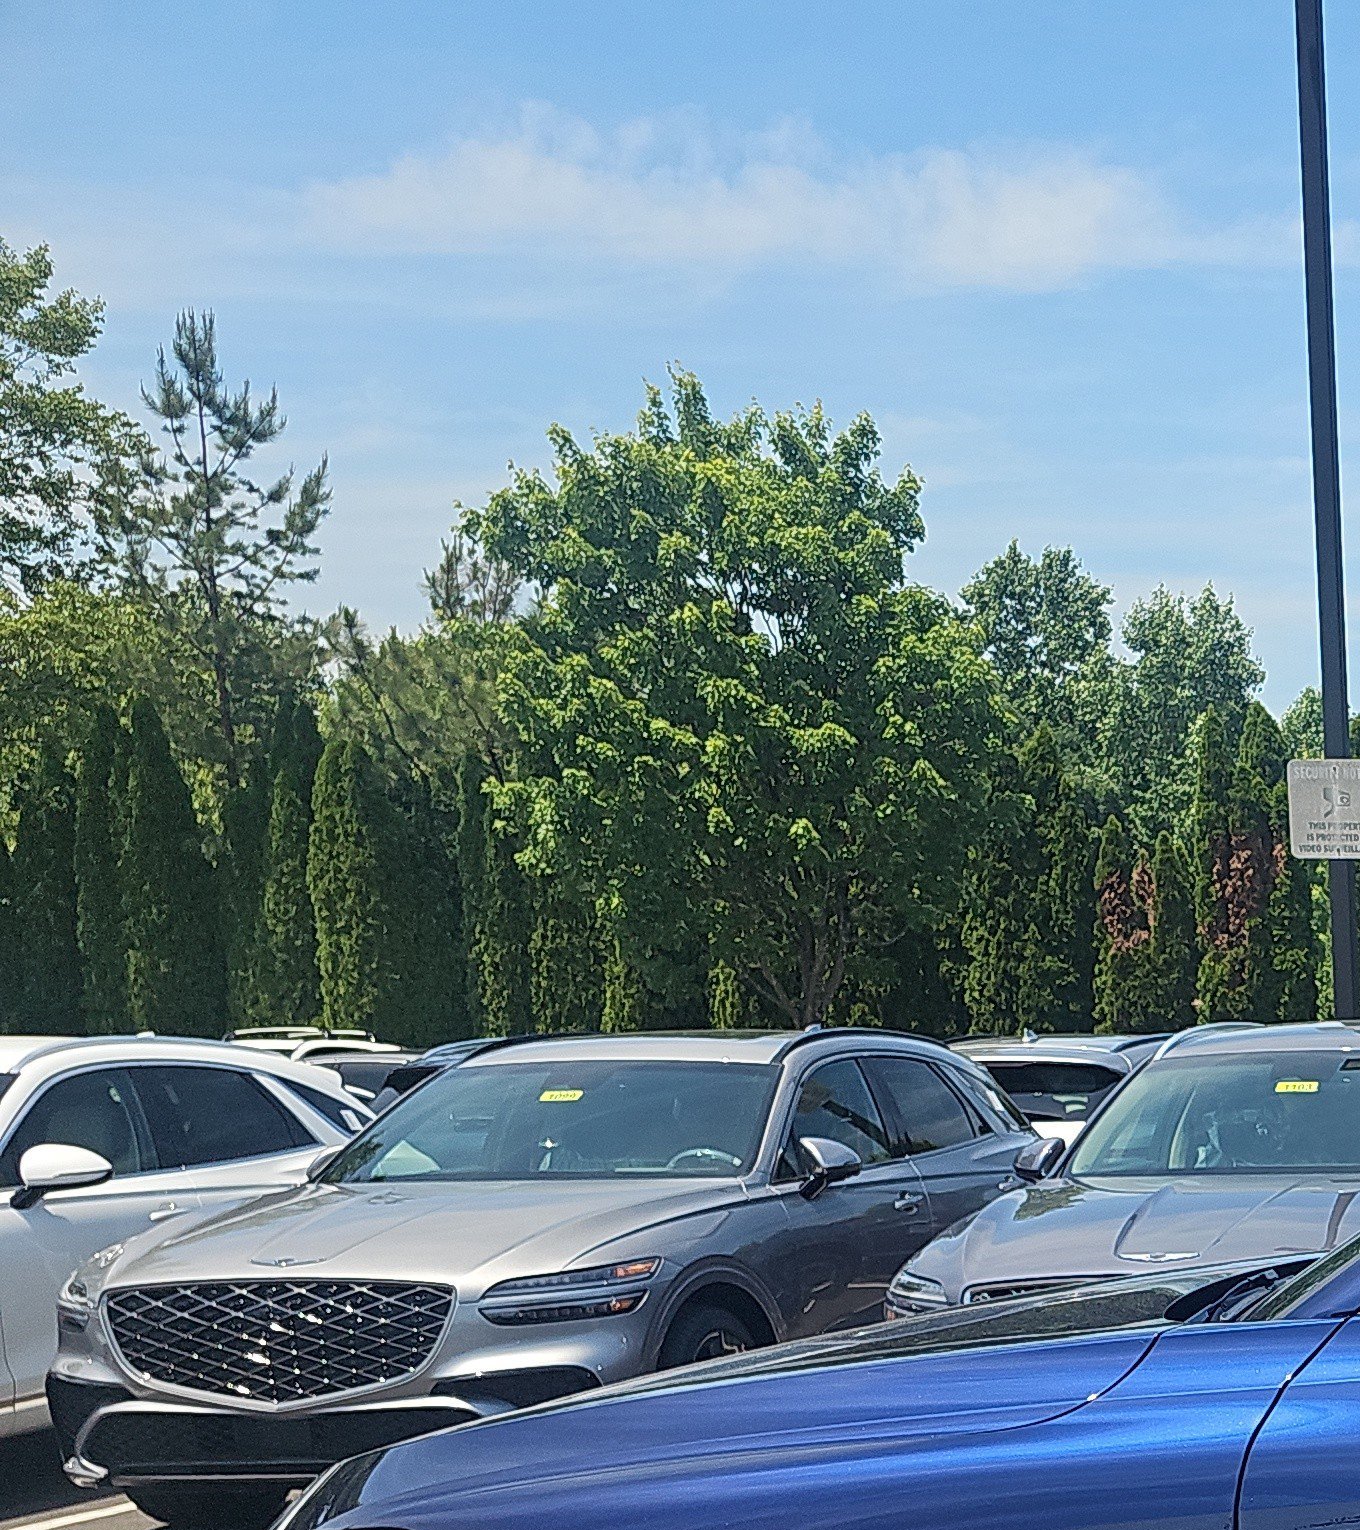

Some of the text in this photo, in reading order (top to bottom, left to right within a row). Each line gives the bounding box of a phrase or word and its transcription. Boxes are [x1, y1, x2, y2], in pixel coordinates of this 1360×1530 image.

[1308, 821, 1326, 830] THIS
[1306, 833, 1314, 842] IS
[1316, 833, 1359, 842] PROTCTED
[1298, 844, 1322, 853] VIDEO
